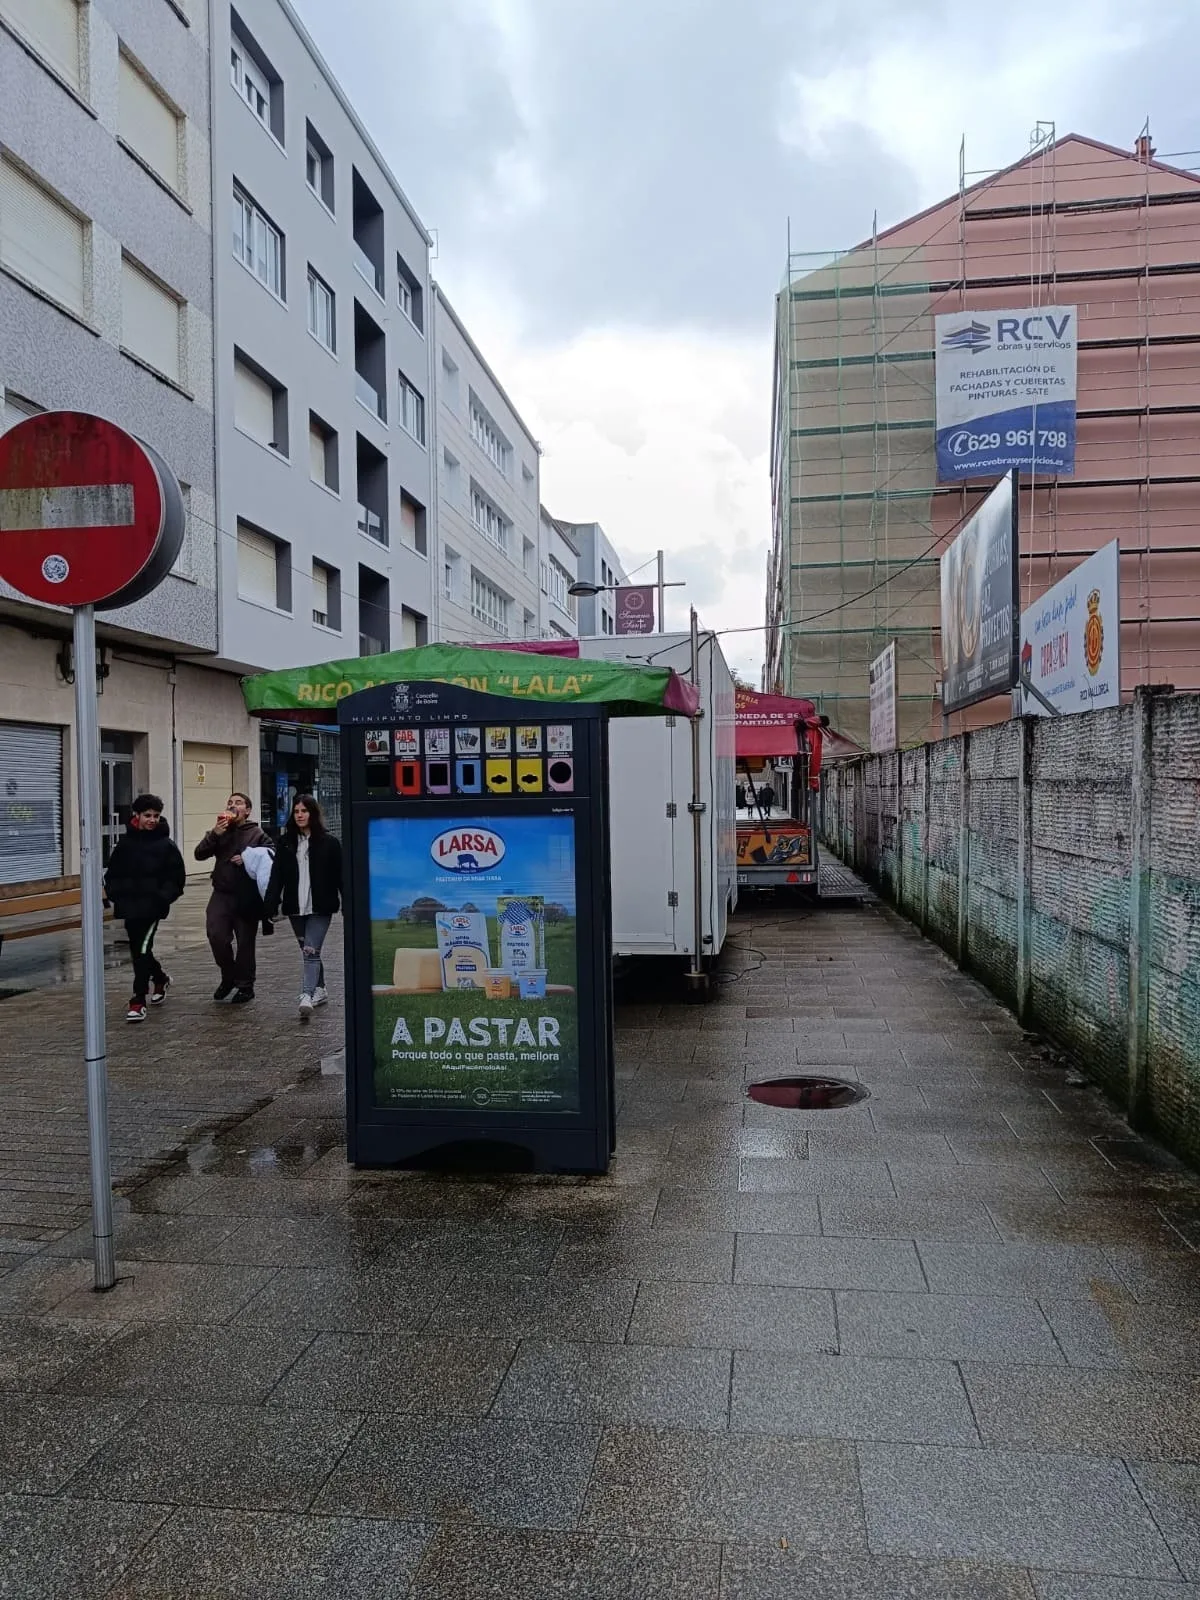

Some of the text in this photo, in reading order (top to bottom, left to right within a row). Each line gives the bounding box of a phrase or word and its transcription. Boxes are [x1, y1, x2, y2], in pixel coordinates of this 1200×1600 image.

[997, 314, 1071, 342] RCV
[997, 342, 1024, 351] obras
[1025, 343, 1032, 351] y
[960, 365, 1056, 380] REHABILITACIÓN DE
[950, 380, 1002, 393] FACHADAS
[1014, 377, 1066, 386] CUBIERTAS
[968, 388, 1018, 400] PINTURAS
[1026, 387, 1049, 396] SATE
[968, 430, 1067, 451] 629 961 798
[953, 456, 1064, 471] www.rcvobrasyservicios.es
[298, 681, 352, 701] RICO
[737, 693, 759, 705] FERIA
[439, 833, 498, 857] LARSA
[391, 1016, 561, 1047] A PASTAR
[392, 1049, 427, 1061] Porque
[429, 1050, 452, 1059] todo
[464, 1052, 484, 1062] que
[486, 1051, 518, 1062] pasta,
[520, 1050, 560, 1060] mellora
